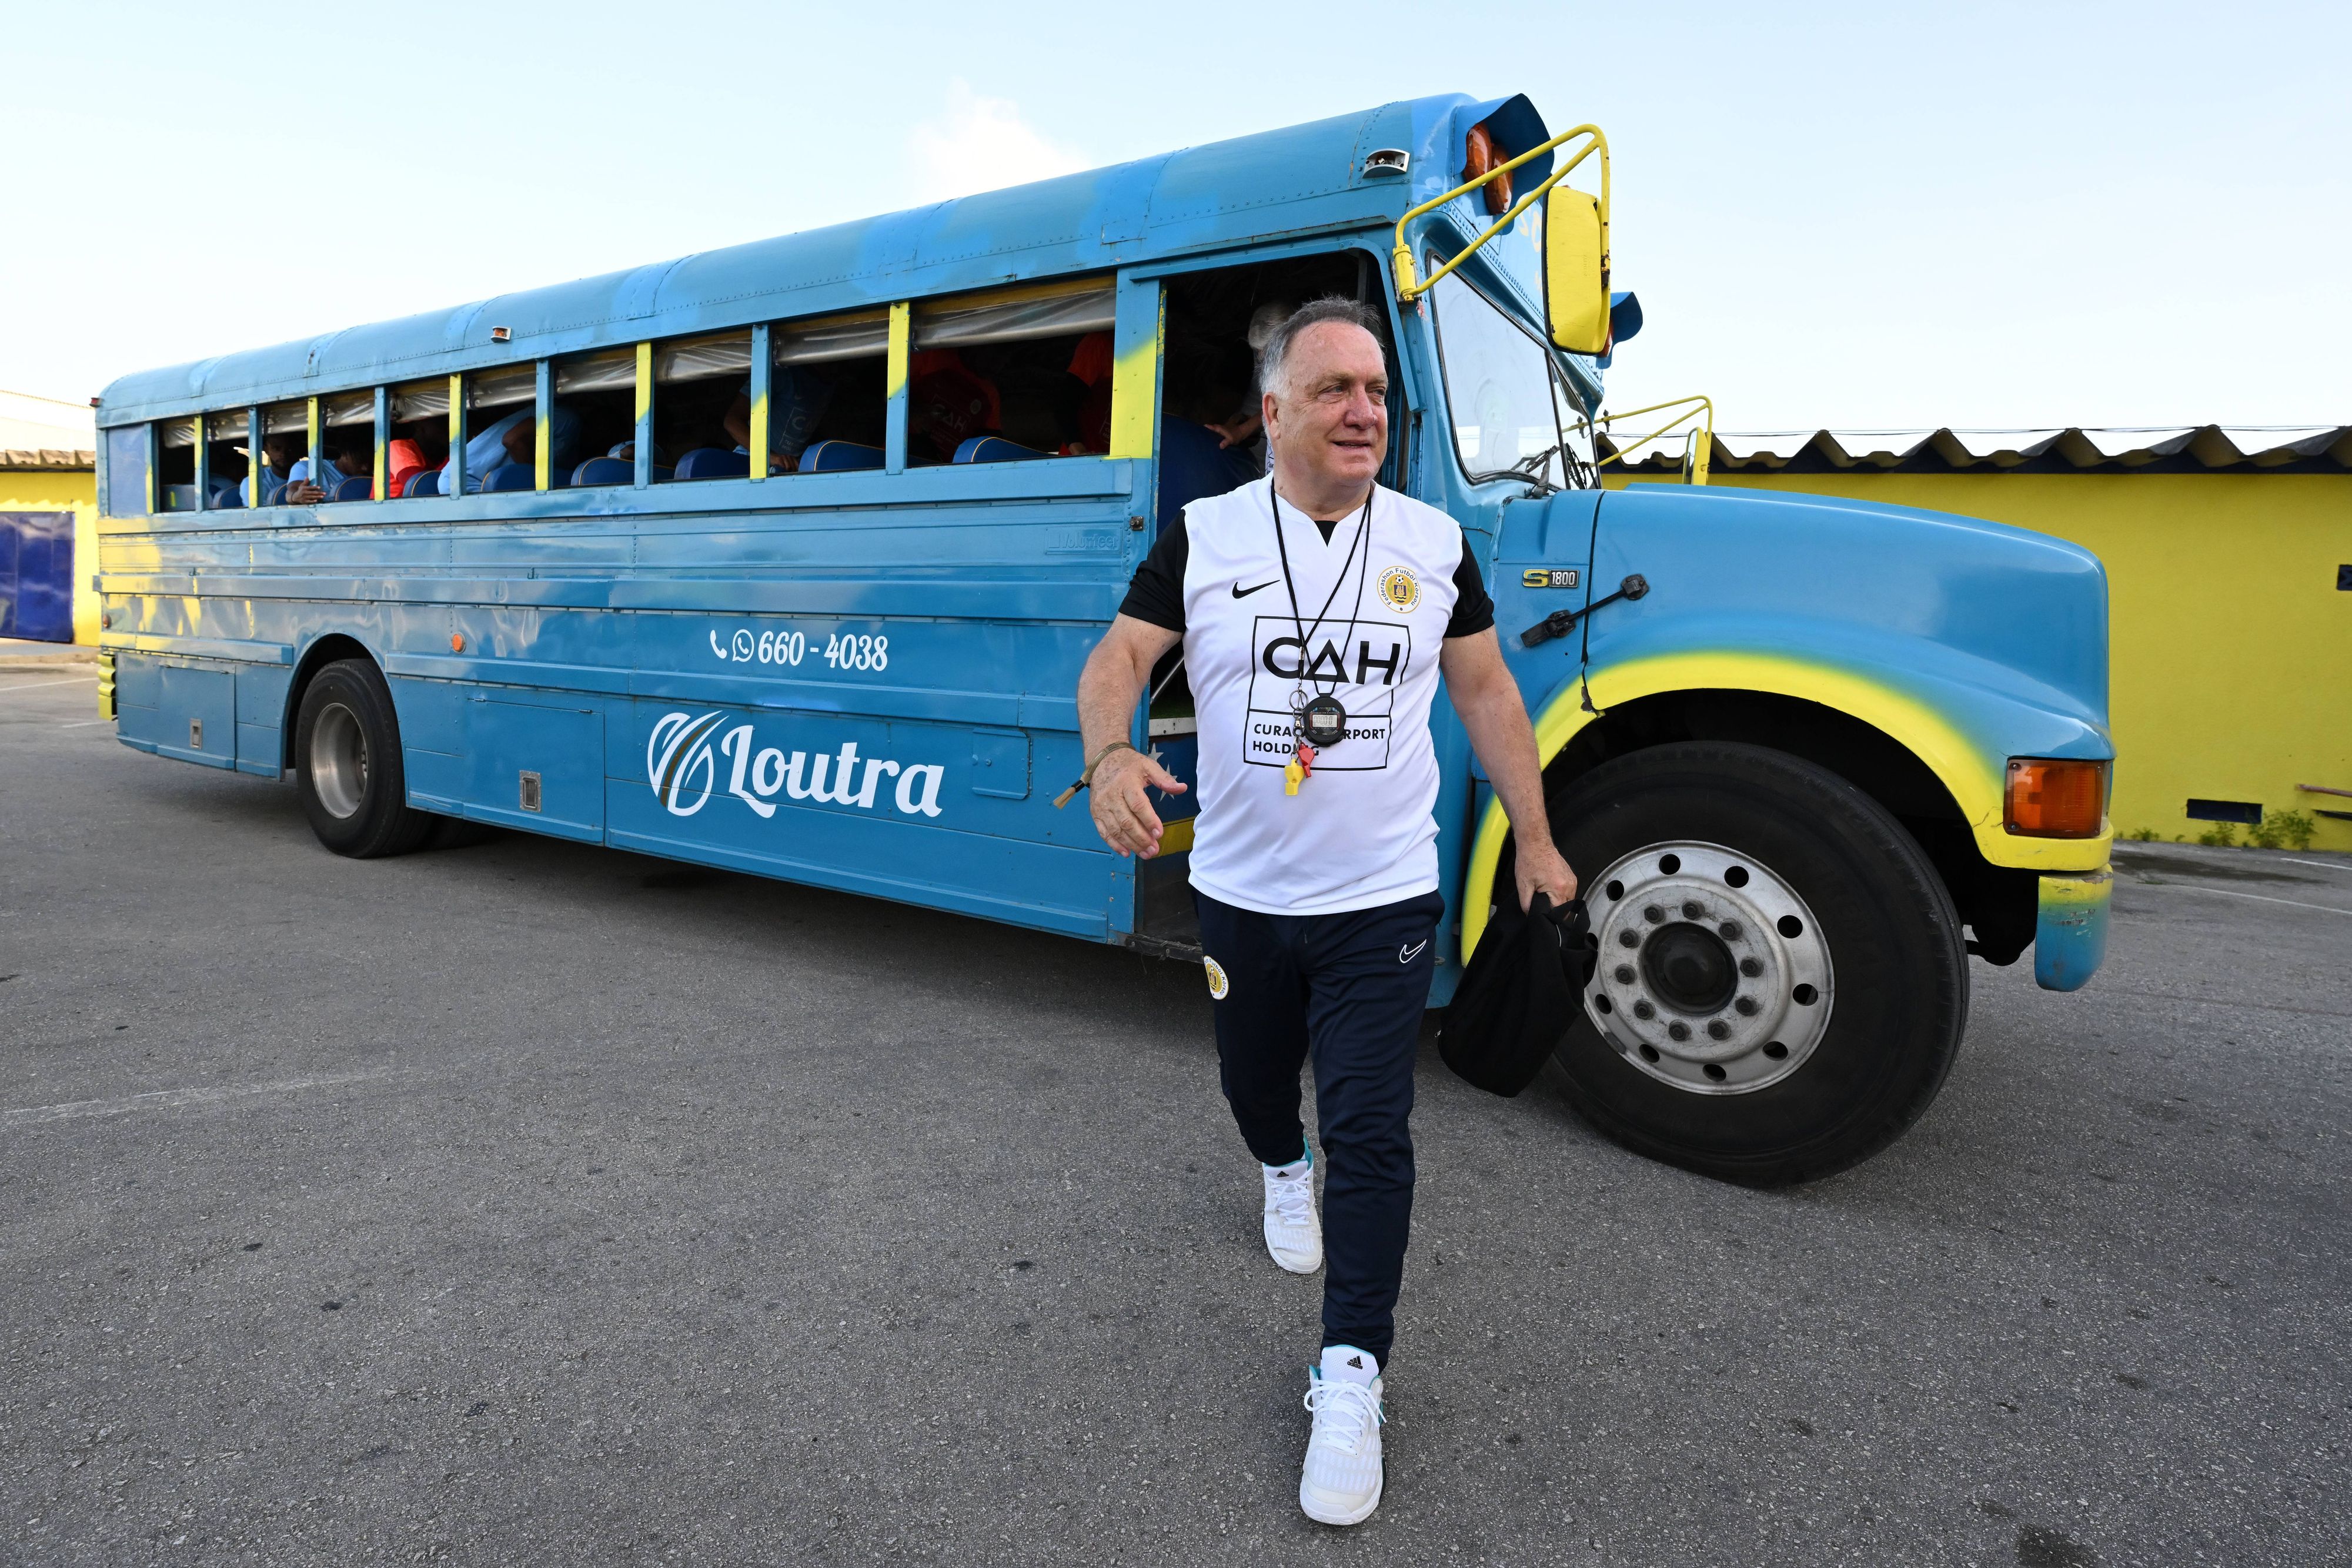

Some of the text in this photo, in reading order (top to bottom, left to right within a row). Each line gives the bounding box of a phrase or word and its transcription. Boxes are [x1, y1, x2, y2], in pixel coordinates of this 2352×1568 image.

[1380, 570, 1394, 606] Federashon
[1552, 571, 1575, 585] 1800
[1254, 723, 1385, 740] CURA RPORT
[721, 725, 945, 818] Loutra
